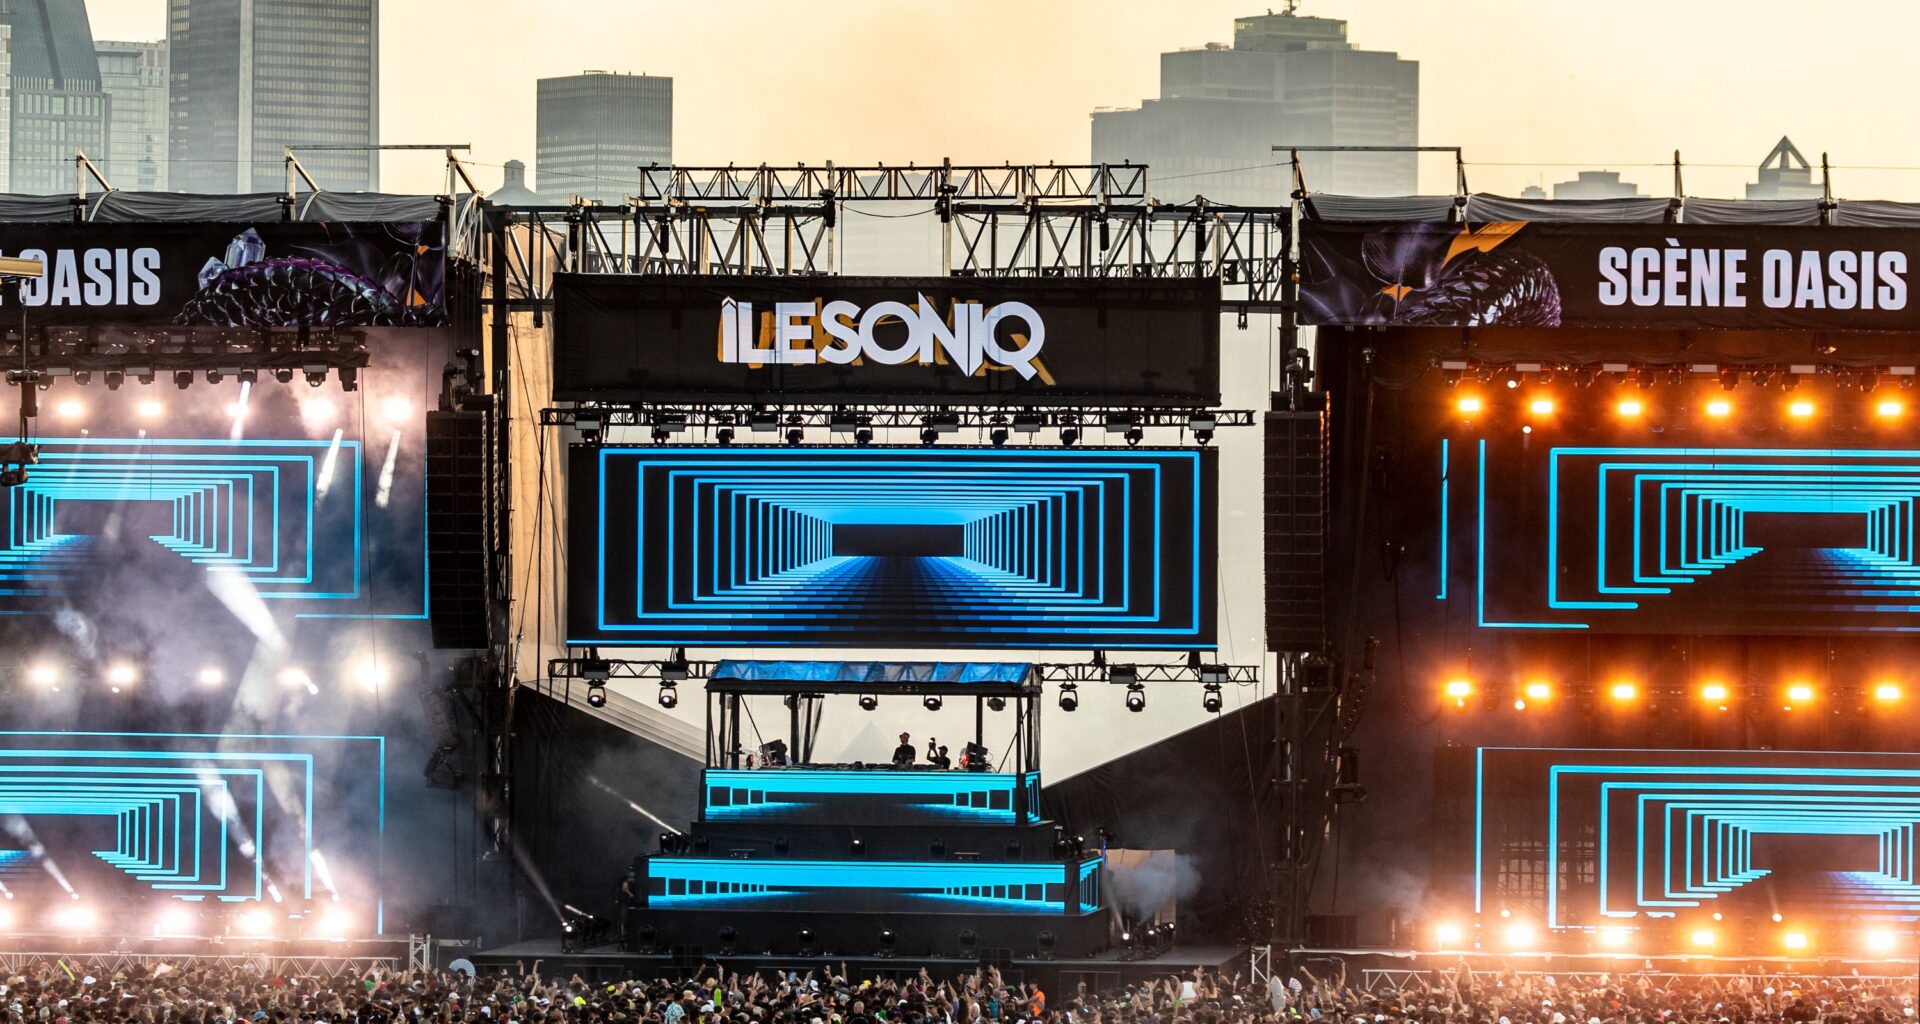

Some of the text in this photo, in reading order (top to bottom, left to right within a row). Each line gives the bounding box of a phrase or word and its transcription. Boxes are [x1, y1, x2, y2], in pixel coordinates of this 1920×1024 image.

[19, 248, 161, 306] OASIS
[1598, 237, 1908, 310] SCÈNE OASIS
[722, 291, 1046, 381] ÎLESONIQ
